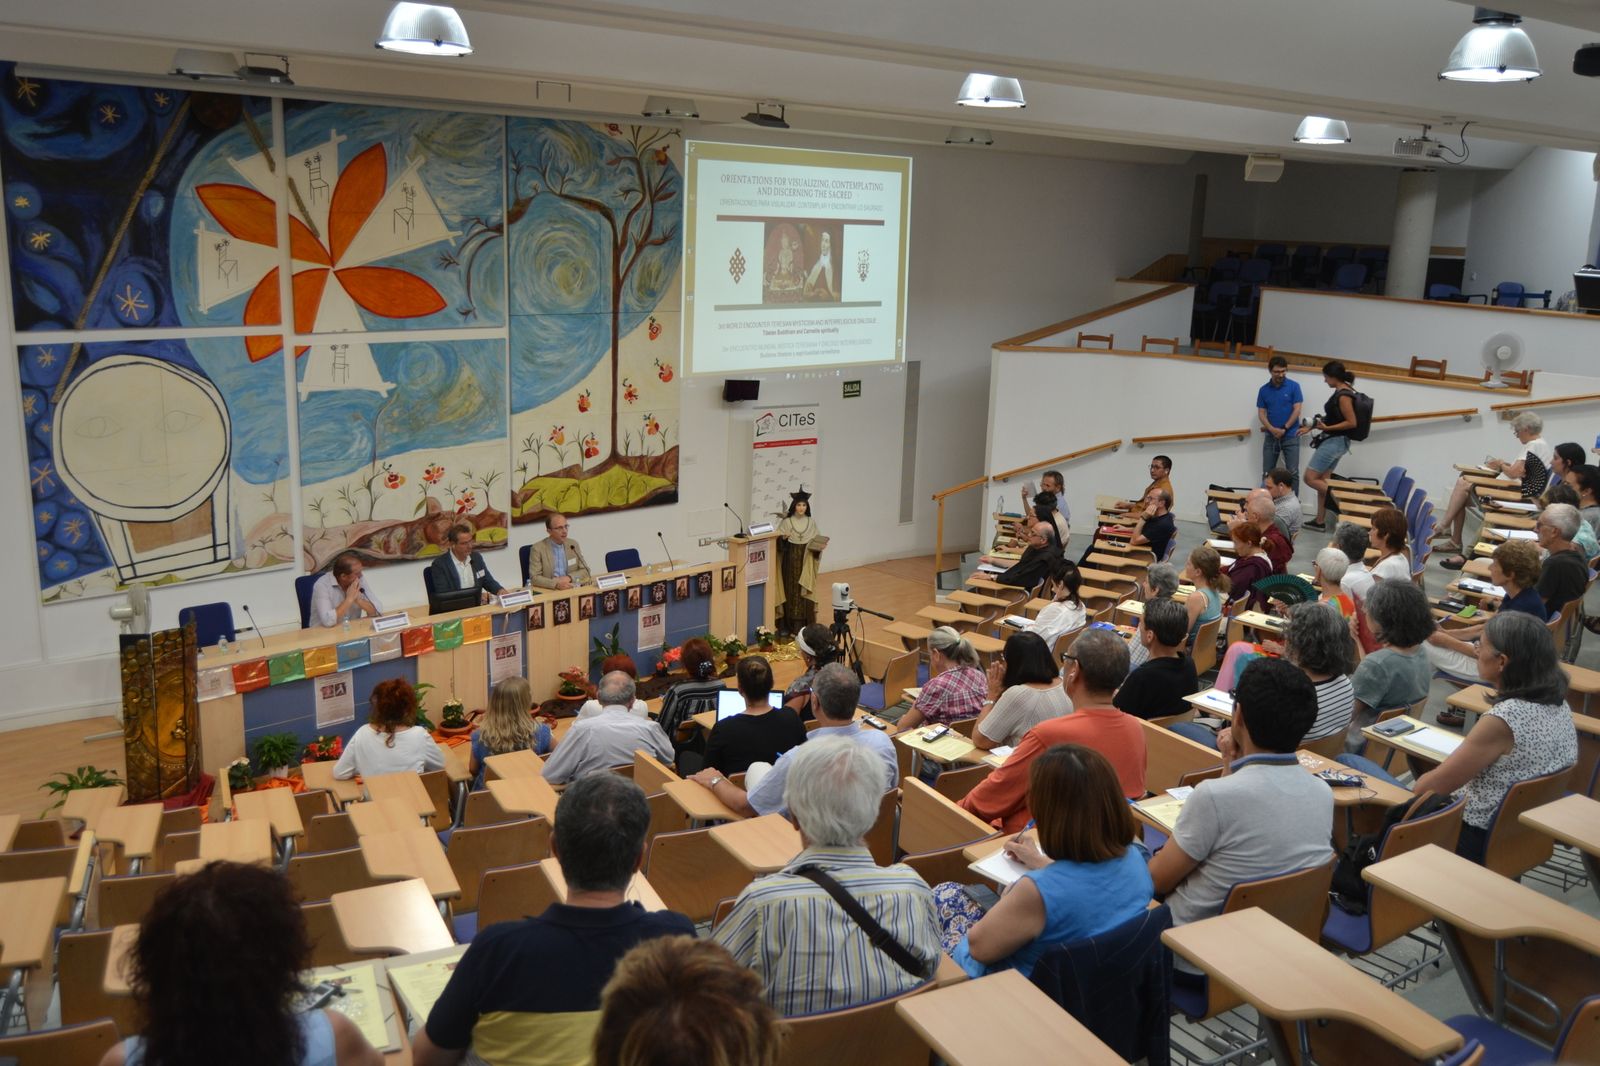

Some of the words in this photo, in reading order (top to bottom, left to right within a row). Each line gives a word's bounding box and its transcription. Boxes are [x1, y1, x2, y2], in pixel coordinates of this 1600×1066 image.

[720, 174, 773, 185] ORIENTATIONS
[774, 176, 786, 186] FOR
[832, 180, 884, 191] CONTEMPLATING
[757, 187, 772, 195] AND
[774, 187, 813, 198] DISCERNING
[814, 189, 827, 198] THE
[828, 190, 853, 199] SACRED
[844, 384, 859, 392] SALIDA
[778, 412, 816, 427] CITeS
